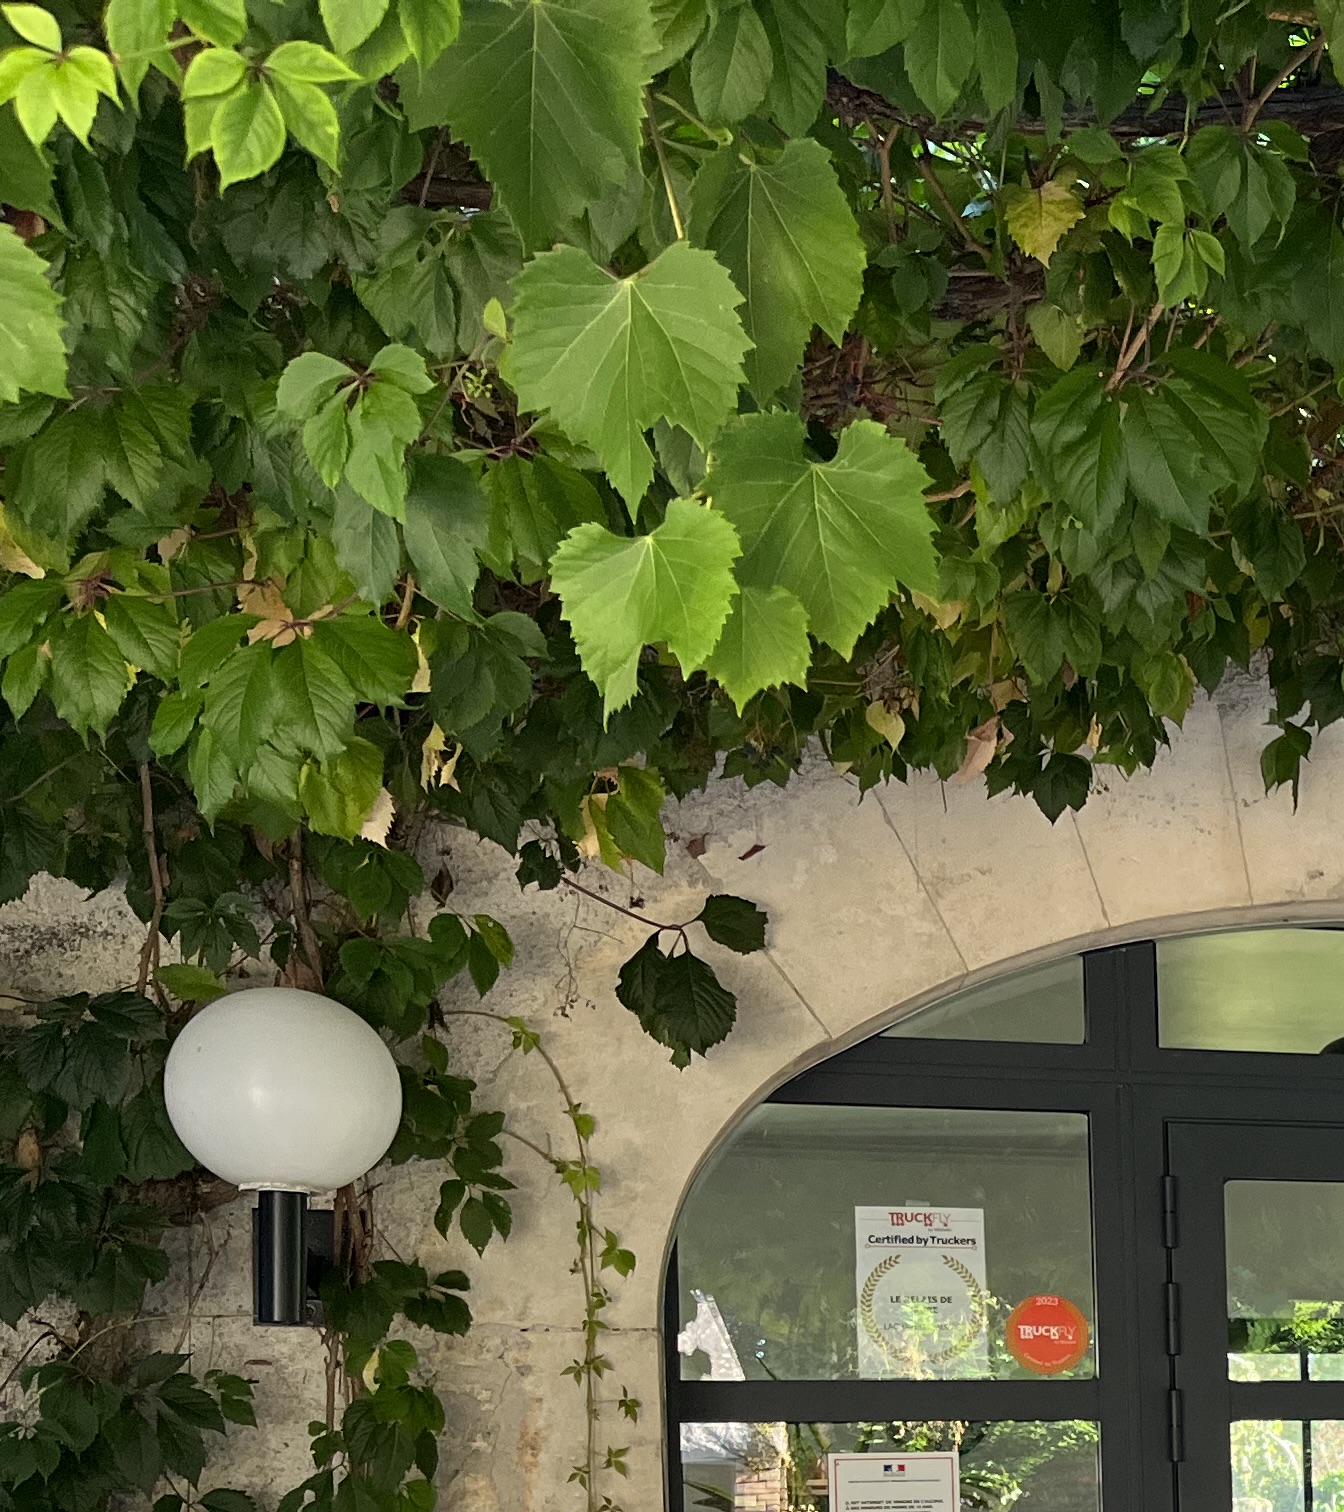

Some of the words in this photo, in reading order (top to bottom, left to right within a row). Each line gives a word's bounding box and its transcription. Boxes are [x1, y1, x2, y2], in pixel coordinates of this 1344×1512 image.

[888, 1212, 951, 1227] TRUCKFLY
[868, 1235, 914, 1245] Certified
[916, 1235, 929, 1246] by
[929, 1236, 977, 1246] Truckers
[940, 1296, 953, 1304] DE
[1035, 1296, 1059, 1306] 2023
[1018, 1325, 1077, 1340] TRUCKFLY
